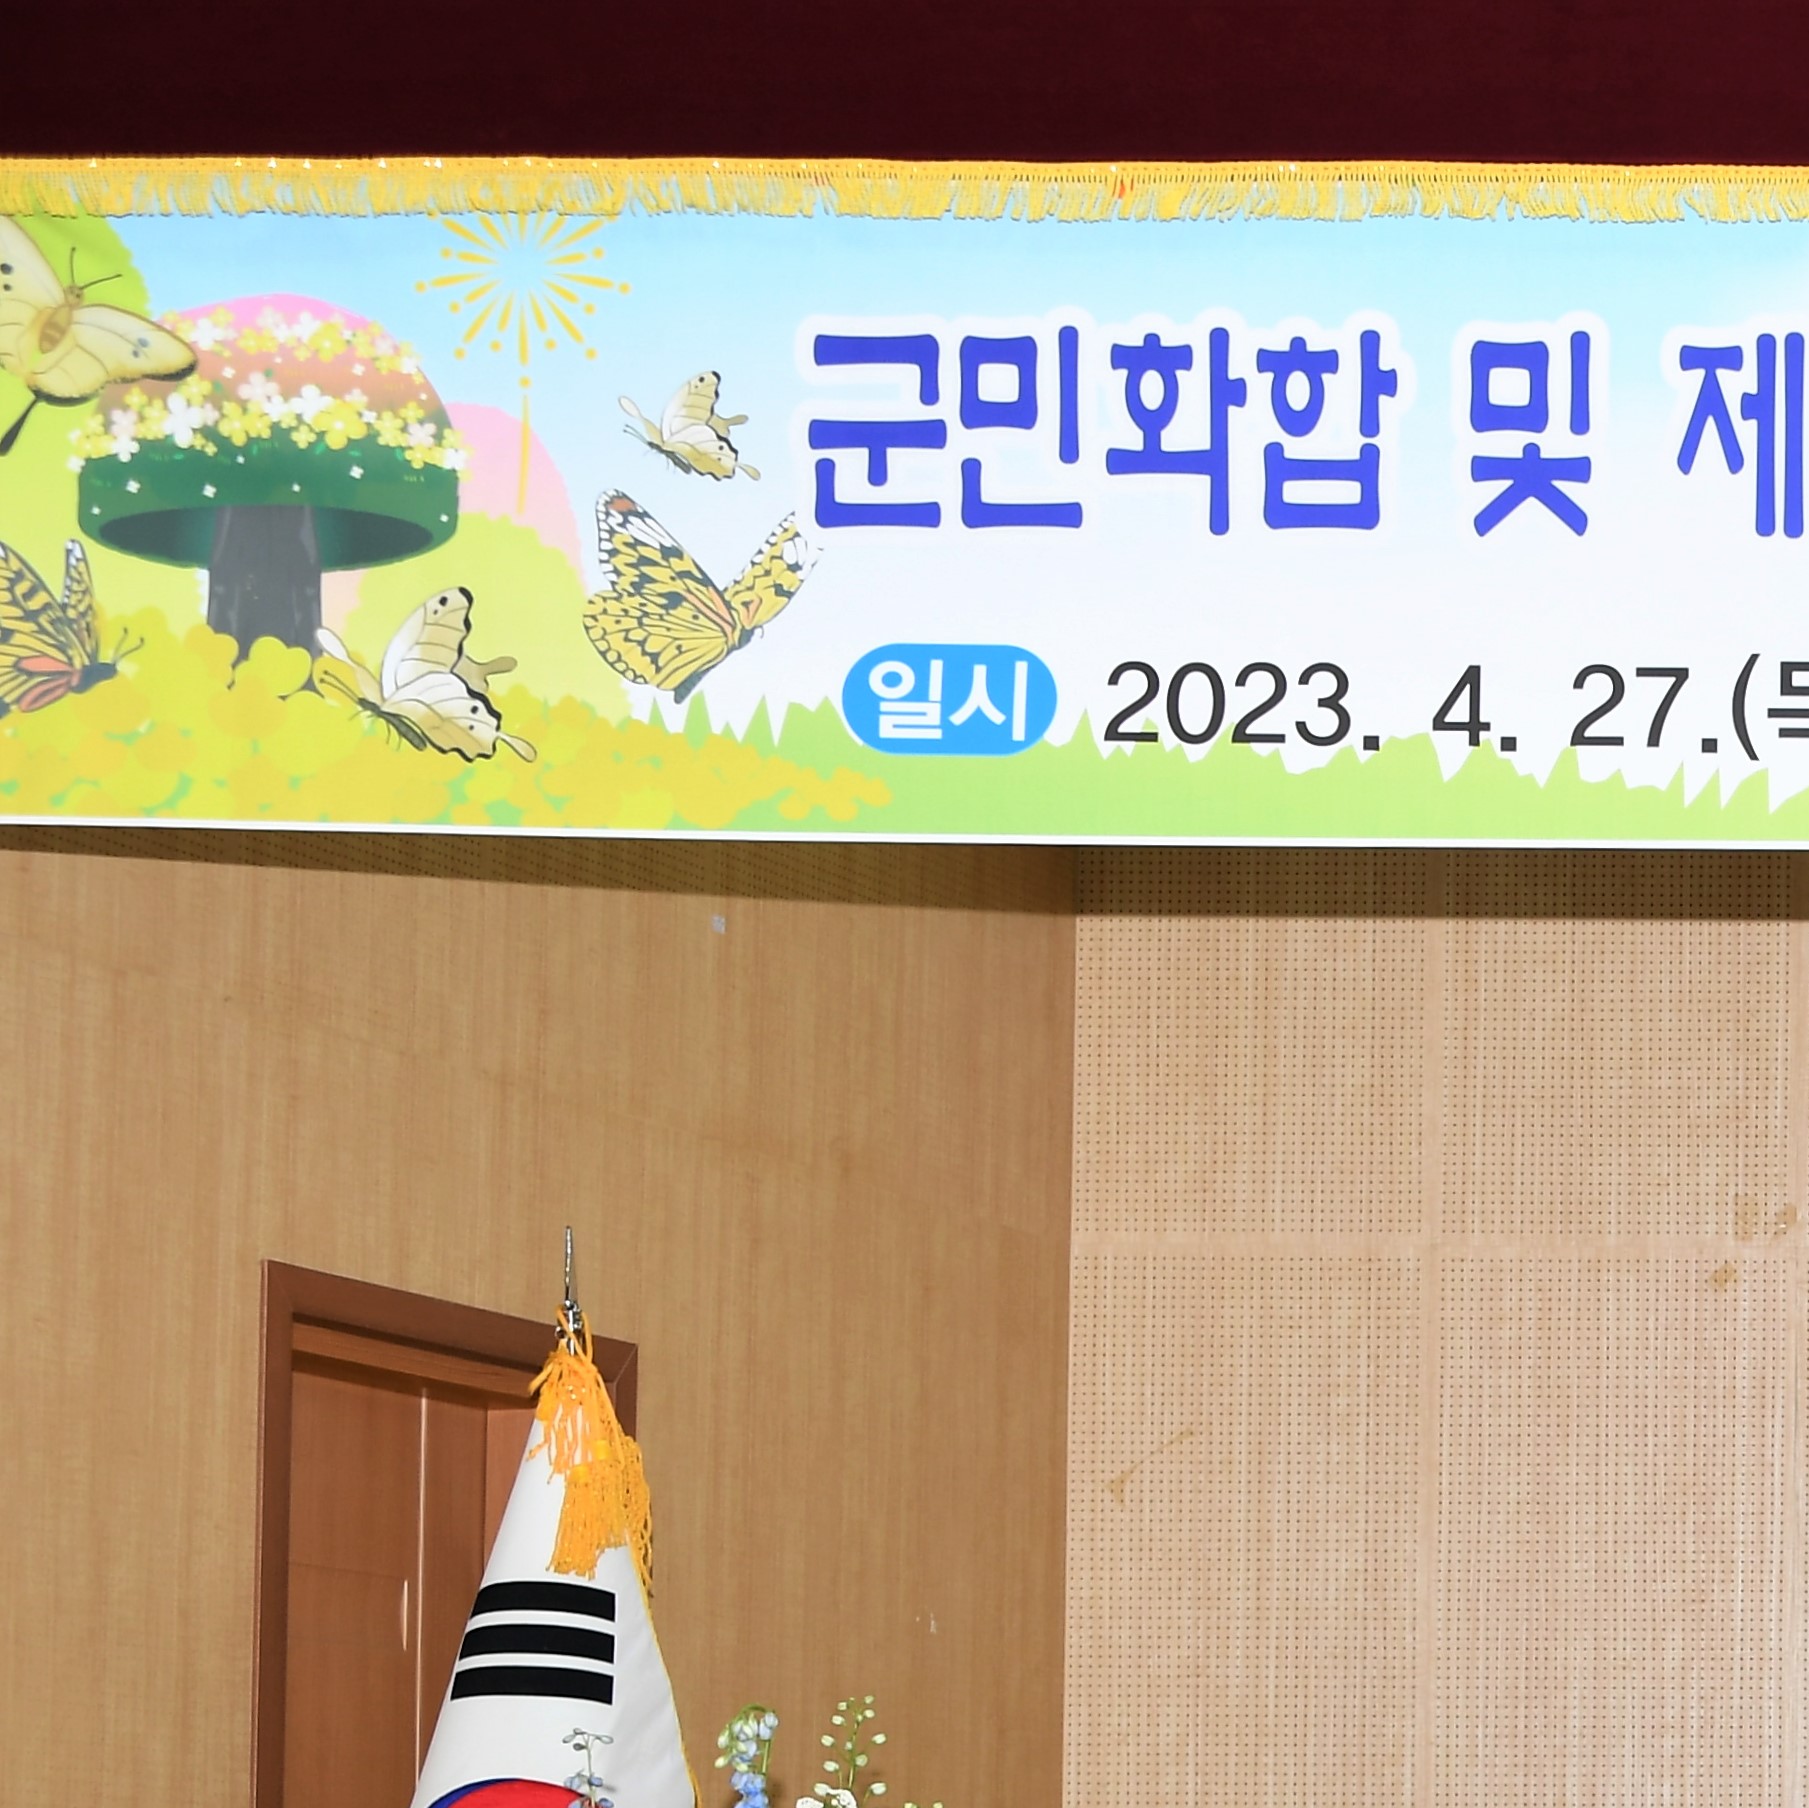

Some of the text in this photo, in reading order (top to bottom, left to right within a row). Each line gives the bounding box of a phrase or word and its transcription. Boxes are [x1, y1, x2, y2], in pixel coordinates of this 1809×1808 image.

[806, 325, 1400, 536] 군민화합
[1468, 330, 1592, 538] 및
[866, 657, 1033, 744] 일시
[1102, 660, 1381, 753] 2023.
[1431, 664, 1518, 753] 4.
